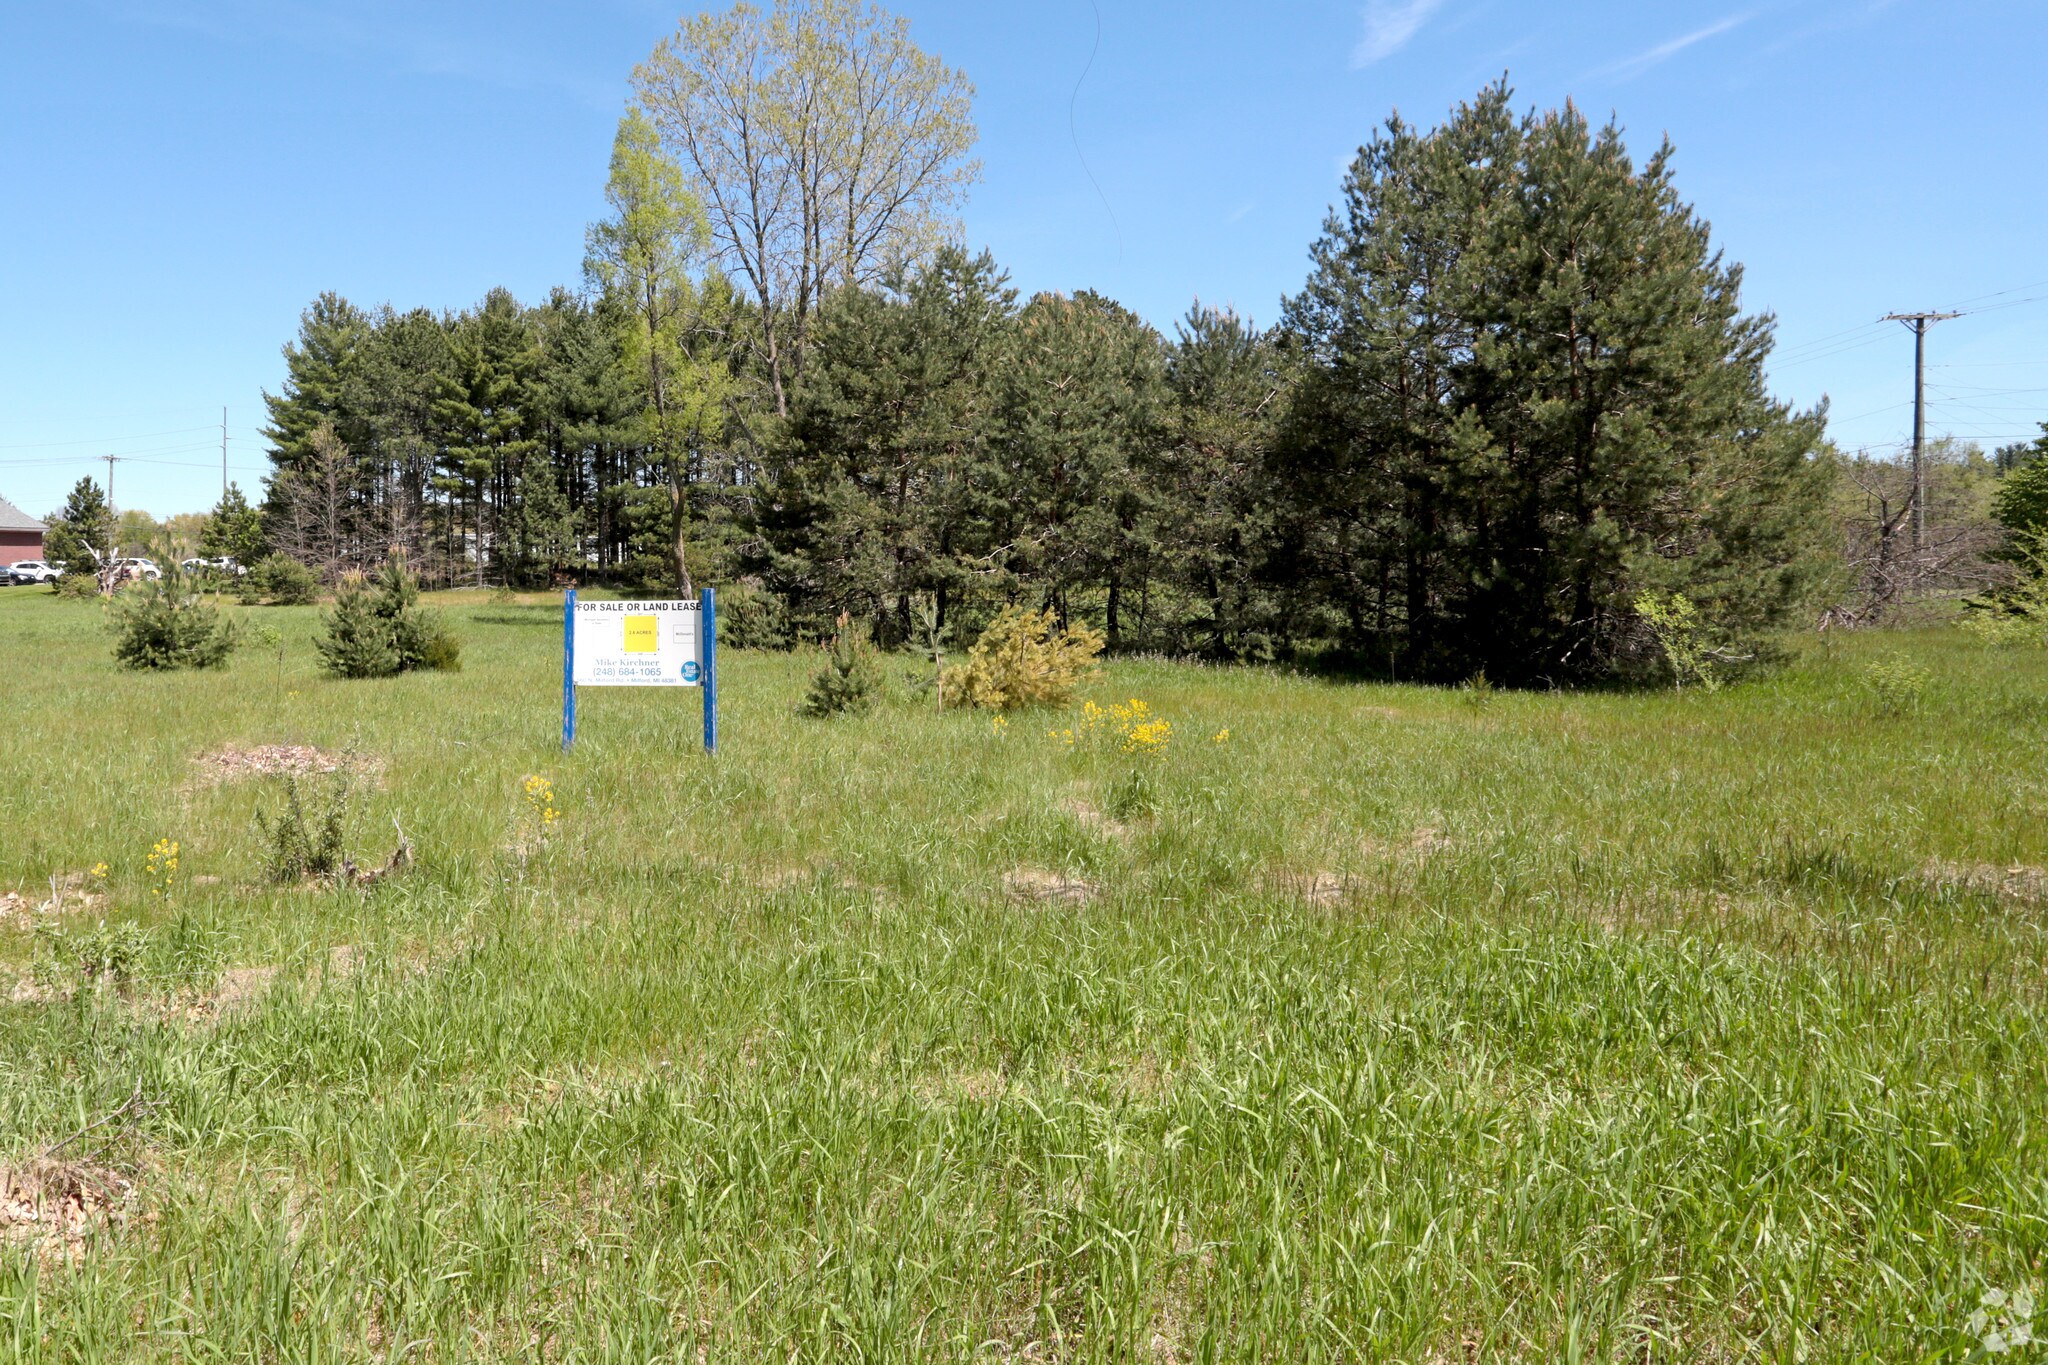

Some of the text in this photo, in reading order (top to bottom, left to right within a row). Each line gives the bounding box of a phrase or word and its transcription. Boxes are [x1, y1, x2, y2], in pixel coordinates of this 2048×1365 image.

[577, 602, 702, 611] FOR SALE OR LAND LEASE
[593, 667, 662, 677] (248) 684-1065
